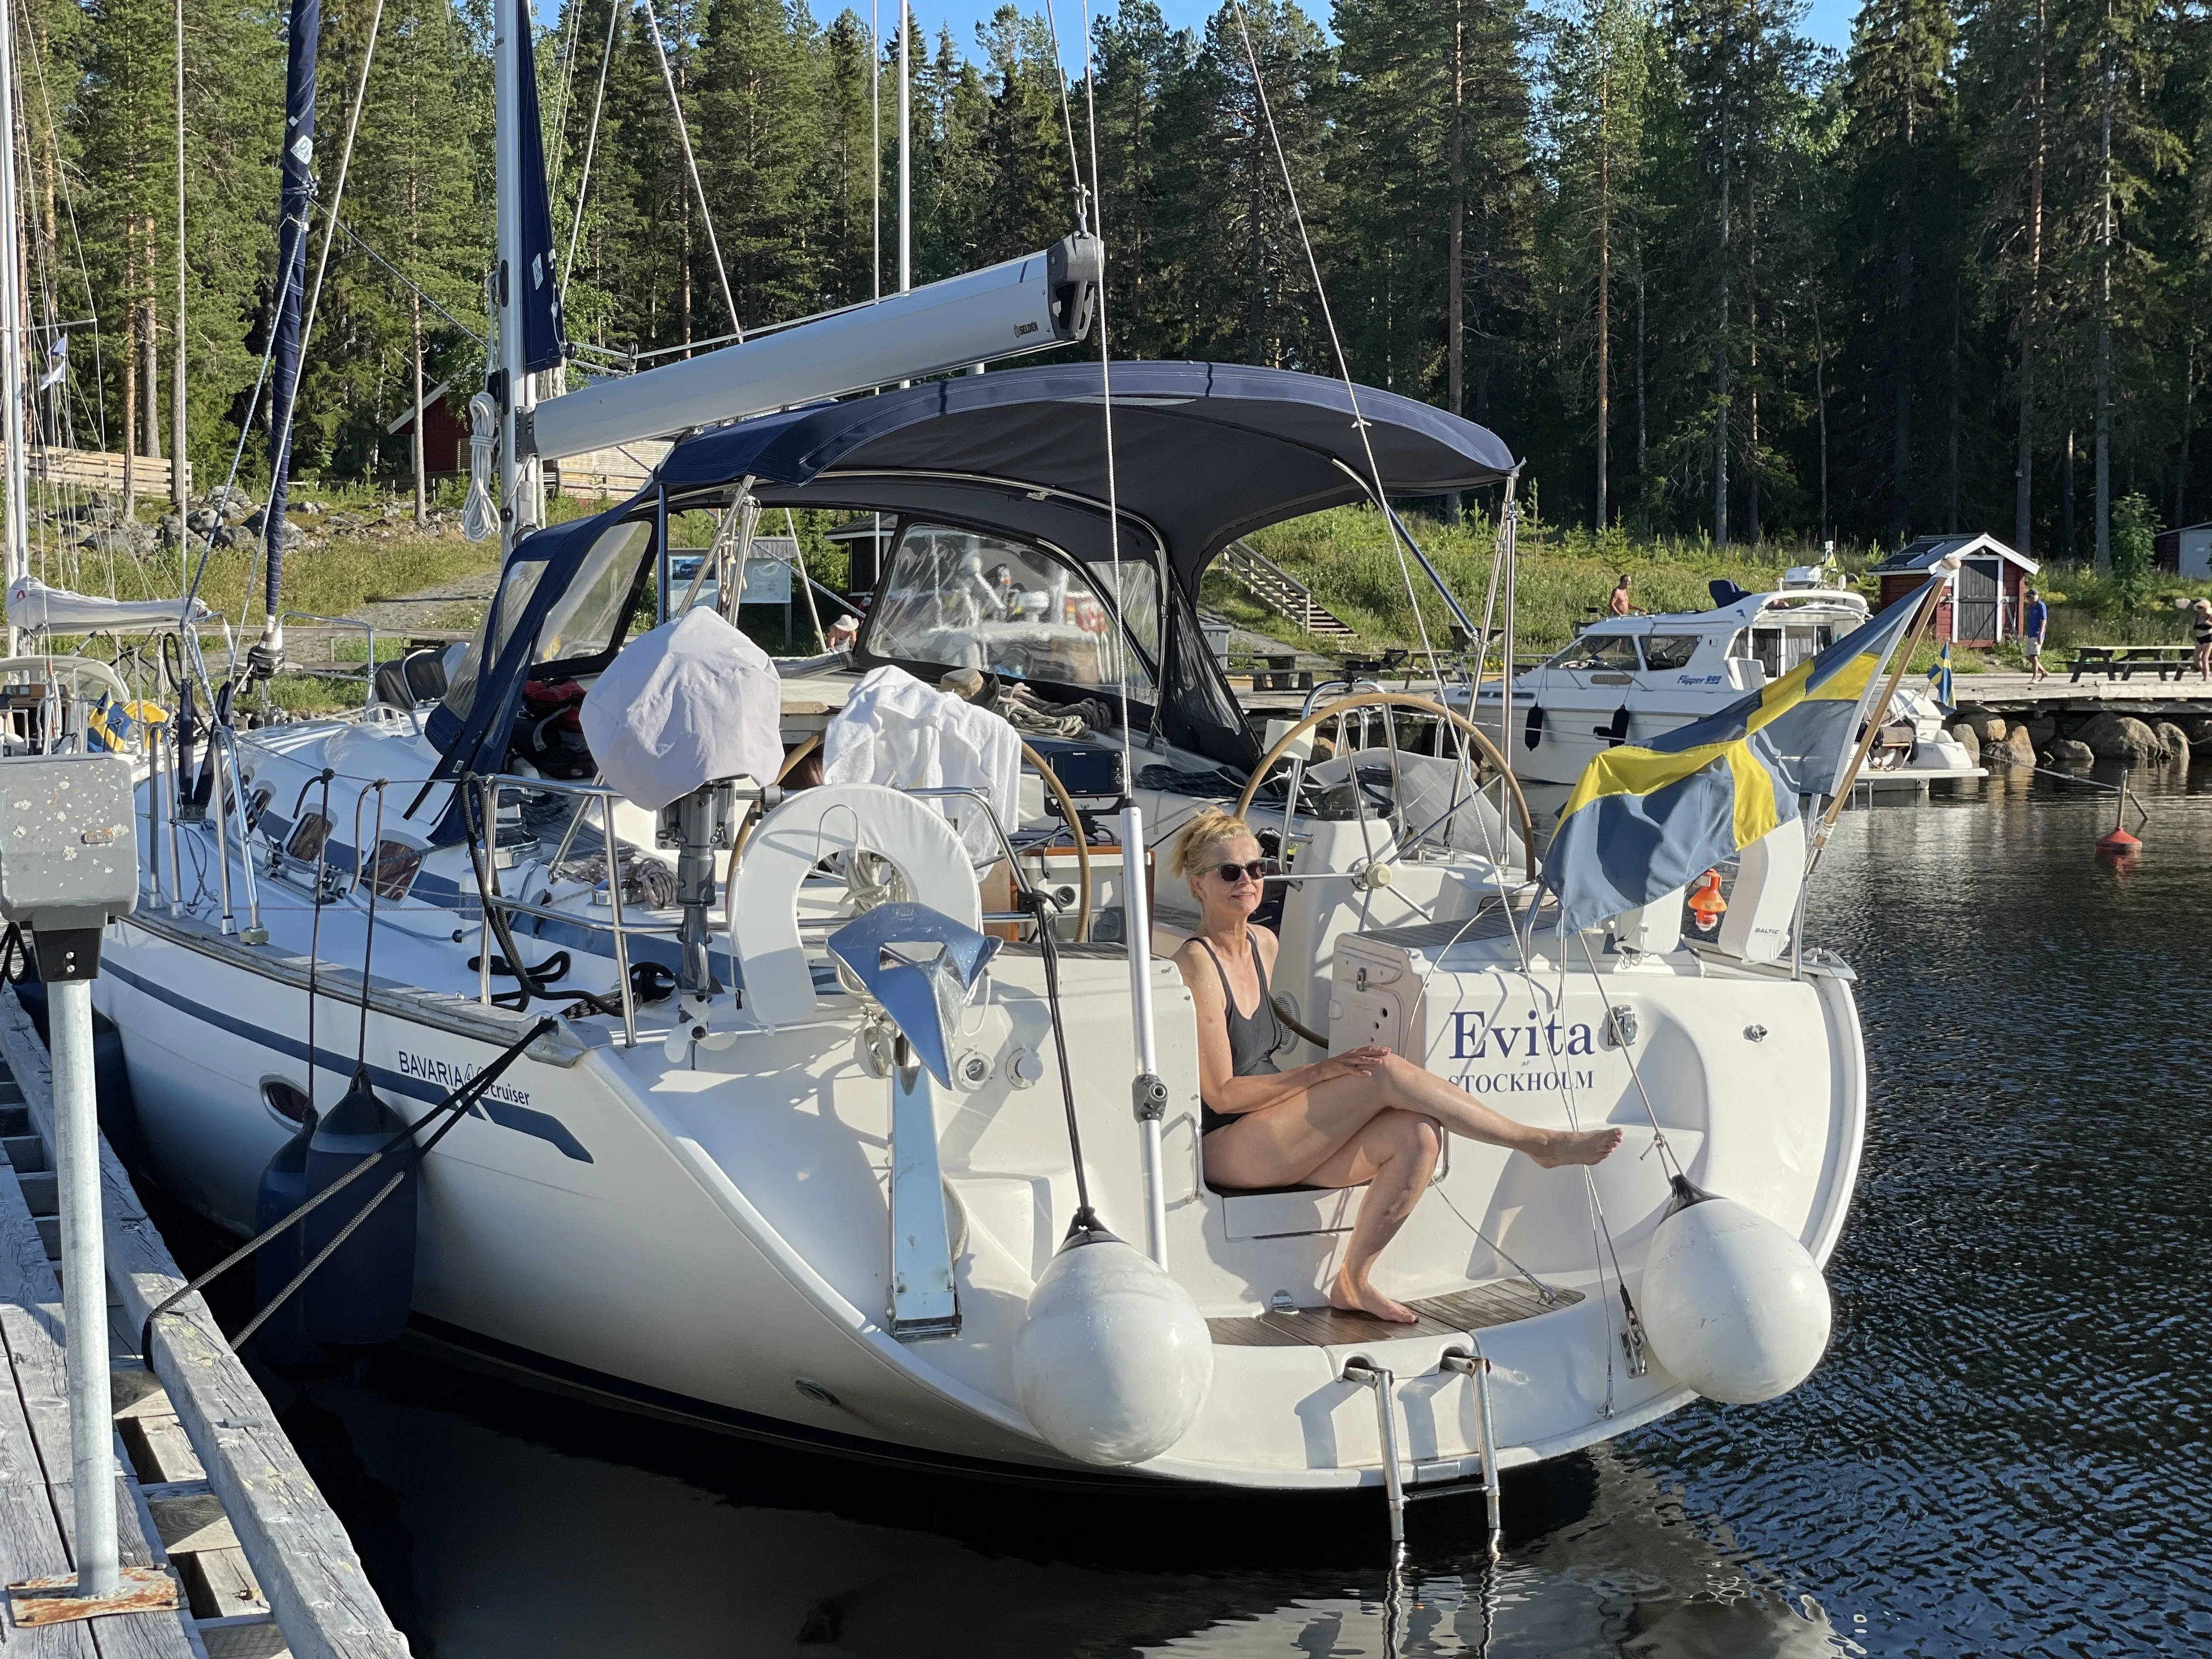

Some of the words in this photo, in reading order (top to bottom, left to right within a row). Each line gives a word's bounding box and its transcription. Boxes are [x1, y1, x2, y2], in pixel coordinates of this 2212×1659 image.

[1677, 675, 1705, 685] Flipper
[1448, 1009, 1595, 1059] Evita
[398, 1050, 464, 1087] BAVARIA
[490, 1083, 531, 1106] cruiser
[1448, 1069, 1594, 1094] STOCKHOLM
